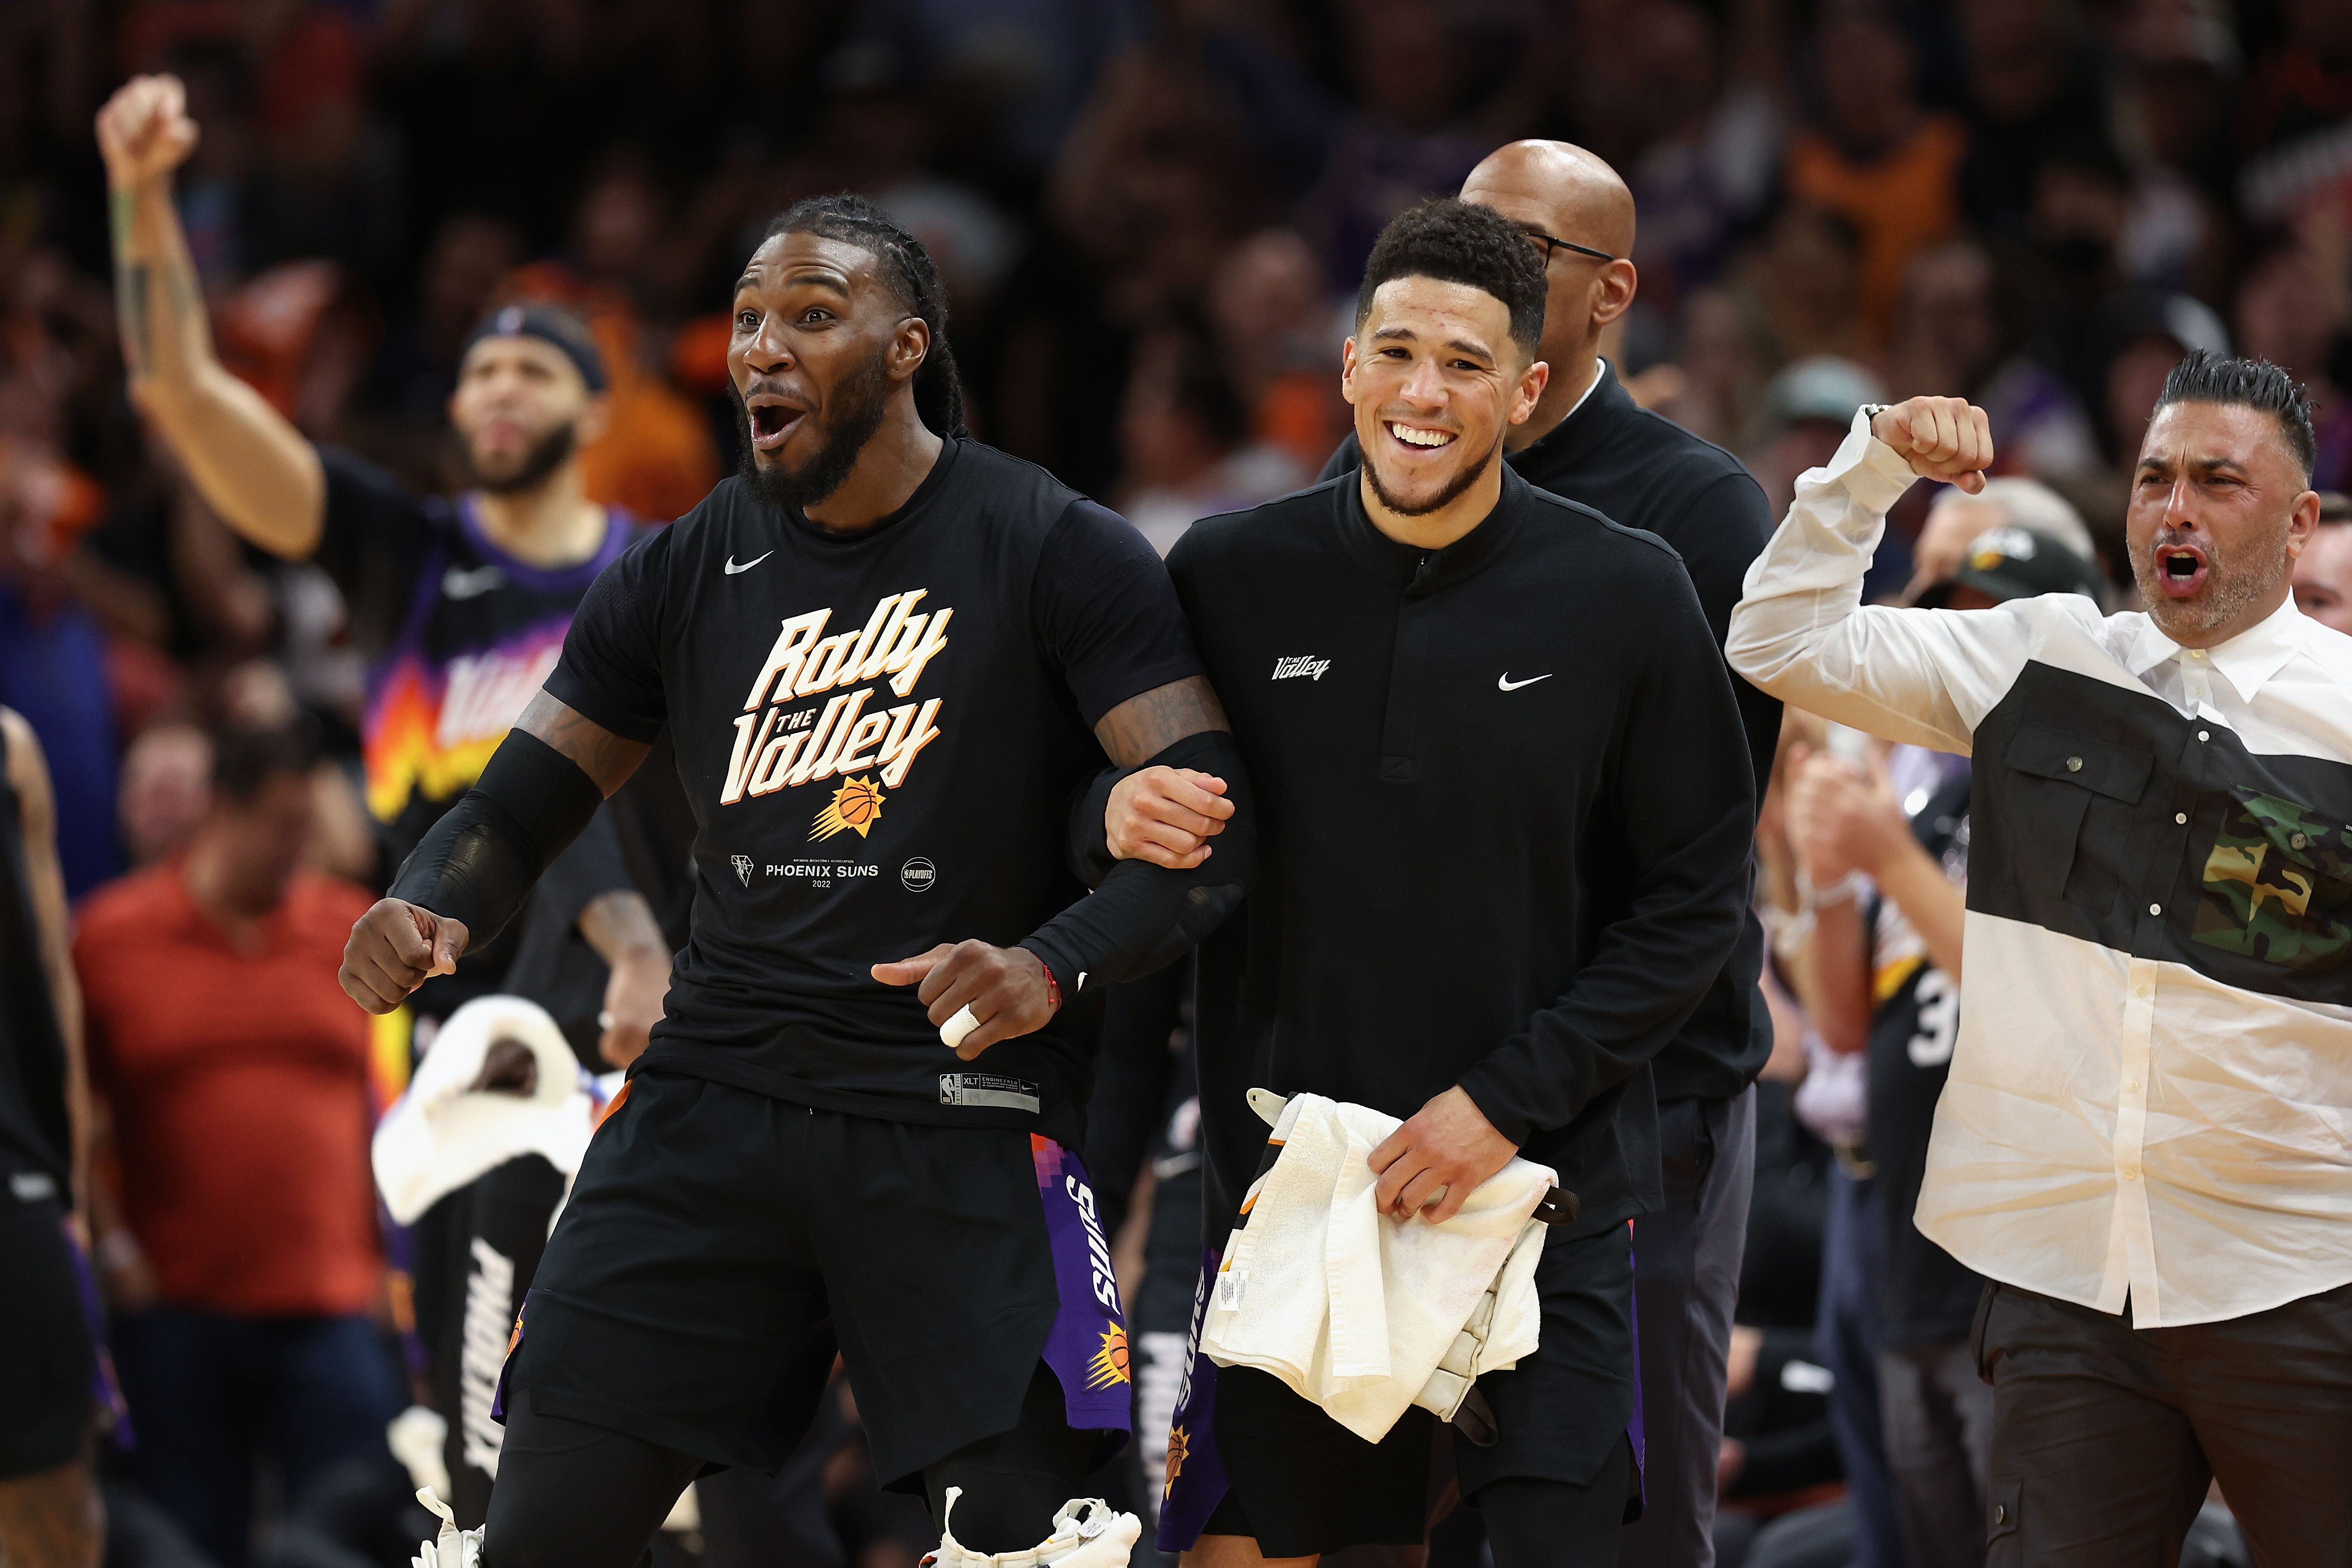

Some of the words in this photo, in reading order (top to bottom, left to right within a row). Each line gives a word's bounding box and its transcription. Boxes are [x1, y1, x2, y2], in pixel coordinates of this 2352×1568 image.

[743, 587, 954, 712] Rally
[1271, 655, 1331, 681] Valley
[778, 708, 817, 733] THE
[720, 687, 943, 806] Valley
[766, 865, 831, 877] PHOENIX
[837, 865, 879, 878] SUNS
[909, 870, 933, 879] PLAYOFFS
[812, 880, 831, 888] 2022
[982, 1077, 1018, 1085] ENGINEERED
